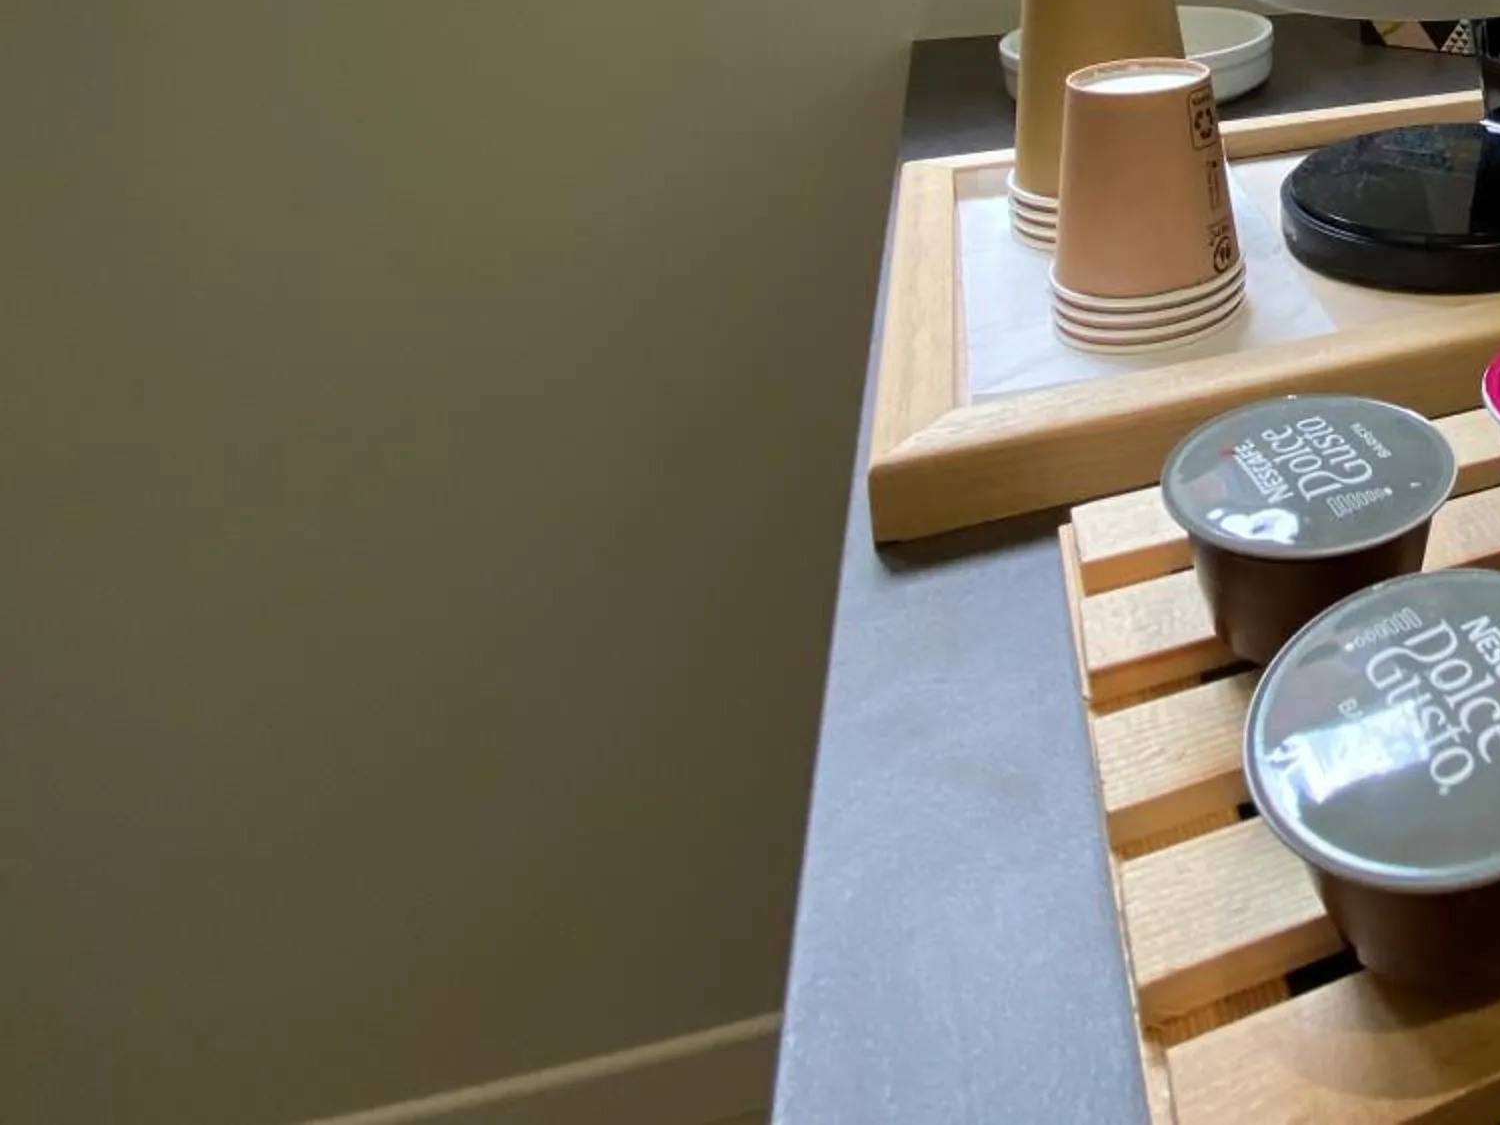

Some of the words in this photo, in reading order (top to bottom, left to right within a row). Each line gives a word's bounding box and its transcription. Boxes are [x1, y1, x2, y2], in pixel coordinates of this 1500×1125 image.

[1261, 425, 1344, 502] Dolce
[1296, 416, 1373, 485] Gusto
[1365, 646, 1475, 789] Gusto
